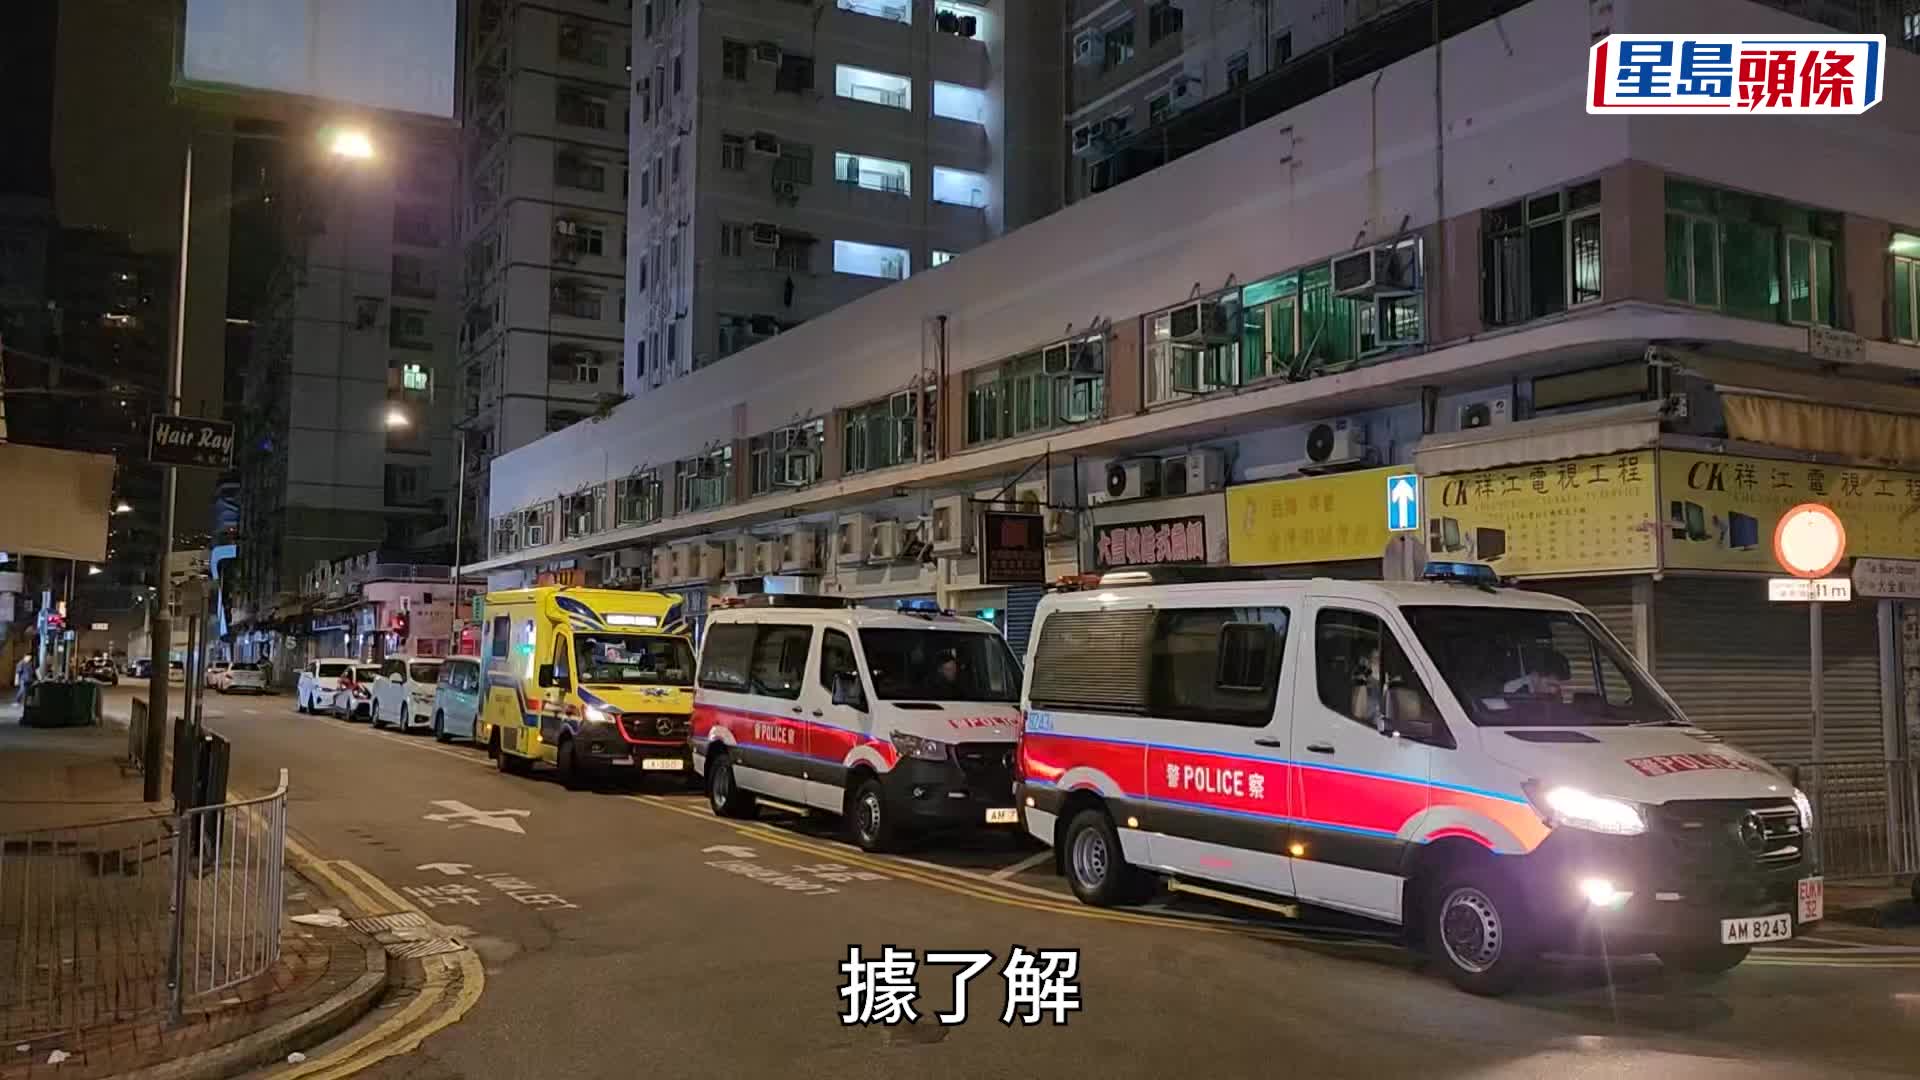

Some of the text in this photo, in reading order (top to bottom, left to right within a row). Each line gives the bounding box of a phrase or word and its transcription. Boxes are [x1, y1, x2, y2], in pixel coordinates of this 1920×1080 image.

[156, 423, 232, 455] Hair Ray
[1443, 456, 1642, 507] CK 祥江電視工程
[1688, 461, 1729, 491] CK
[1831, 587, 1847, 597] m
[761, 722, 787, 744] POLICE
[1183, 764, 1244, 797] POLICE
[1248, 772, 1265, 799] 察
[1728, 919, 1788, 940] AM 8243
